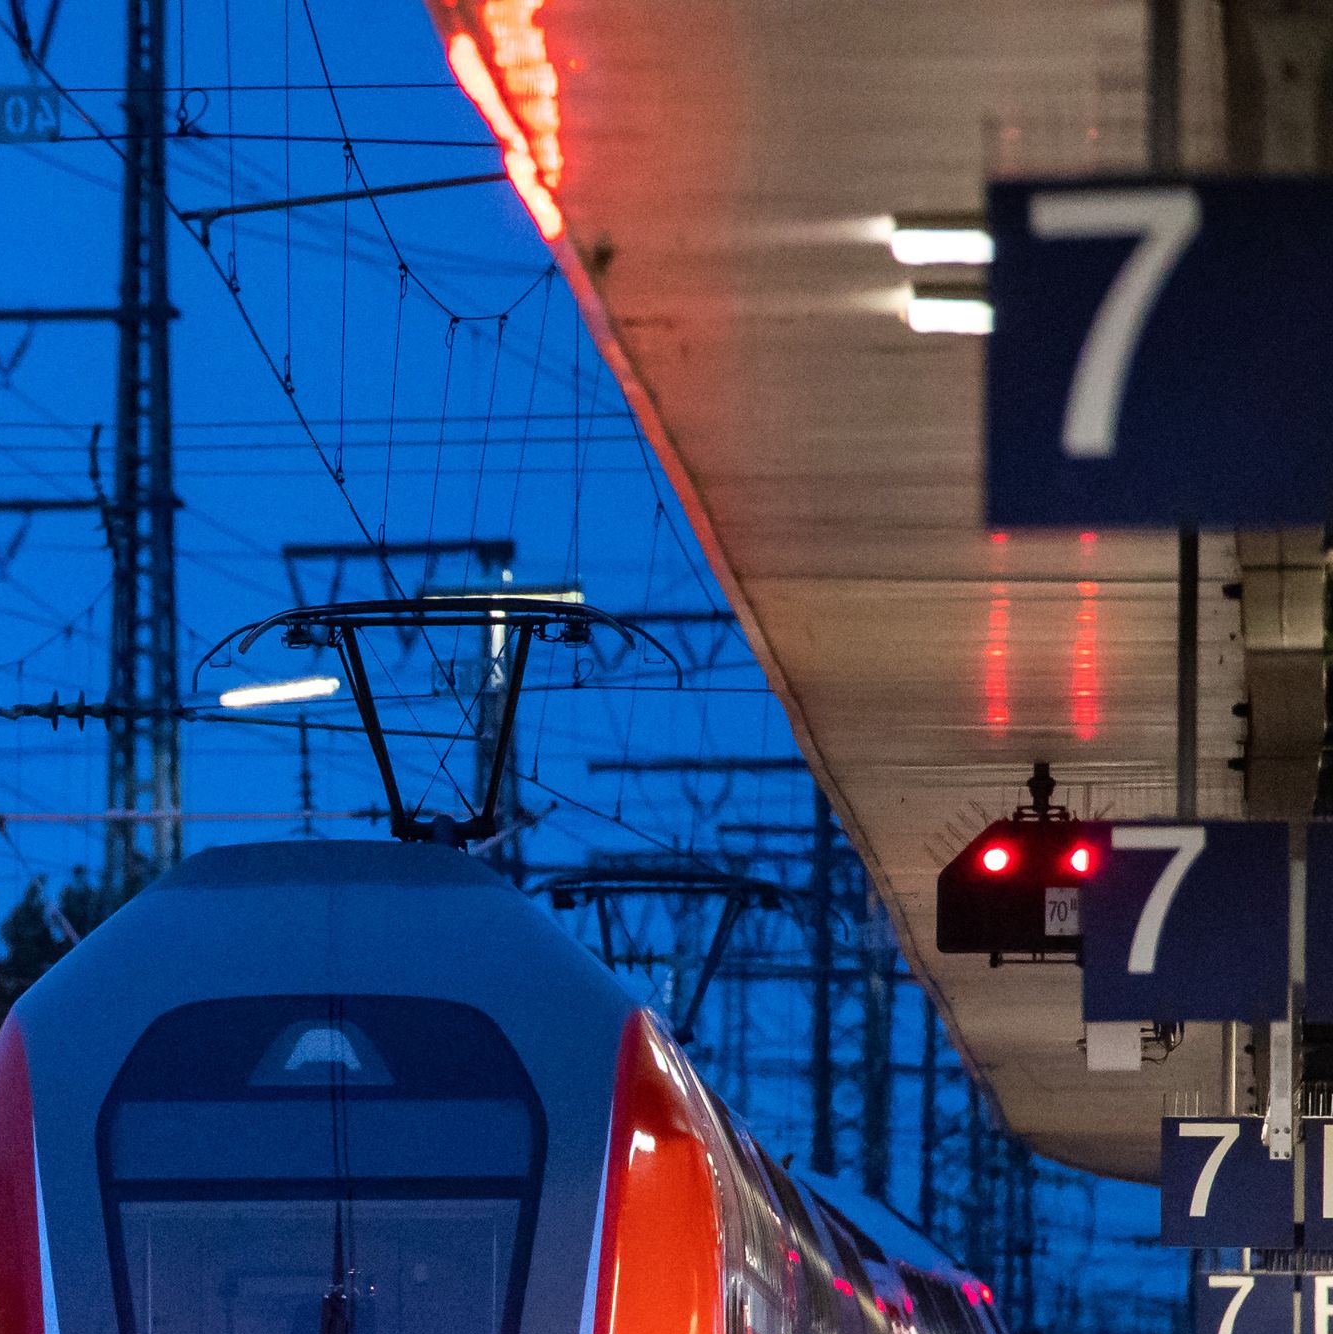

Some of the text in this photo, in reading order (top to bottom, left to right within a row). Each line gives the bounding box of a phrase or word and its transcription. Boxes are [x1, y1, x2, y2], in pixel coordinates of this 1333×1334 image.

[1030, 190, 1201, 457] 7
[1111, 826, 1206, 974] 7
[1179, 1123, 1240, 1217] 7
